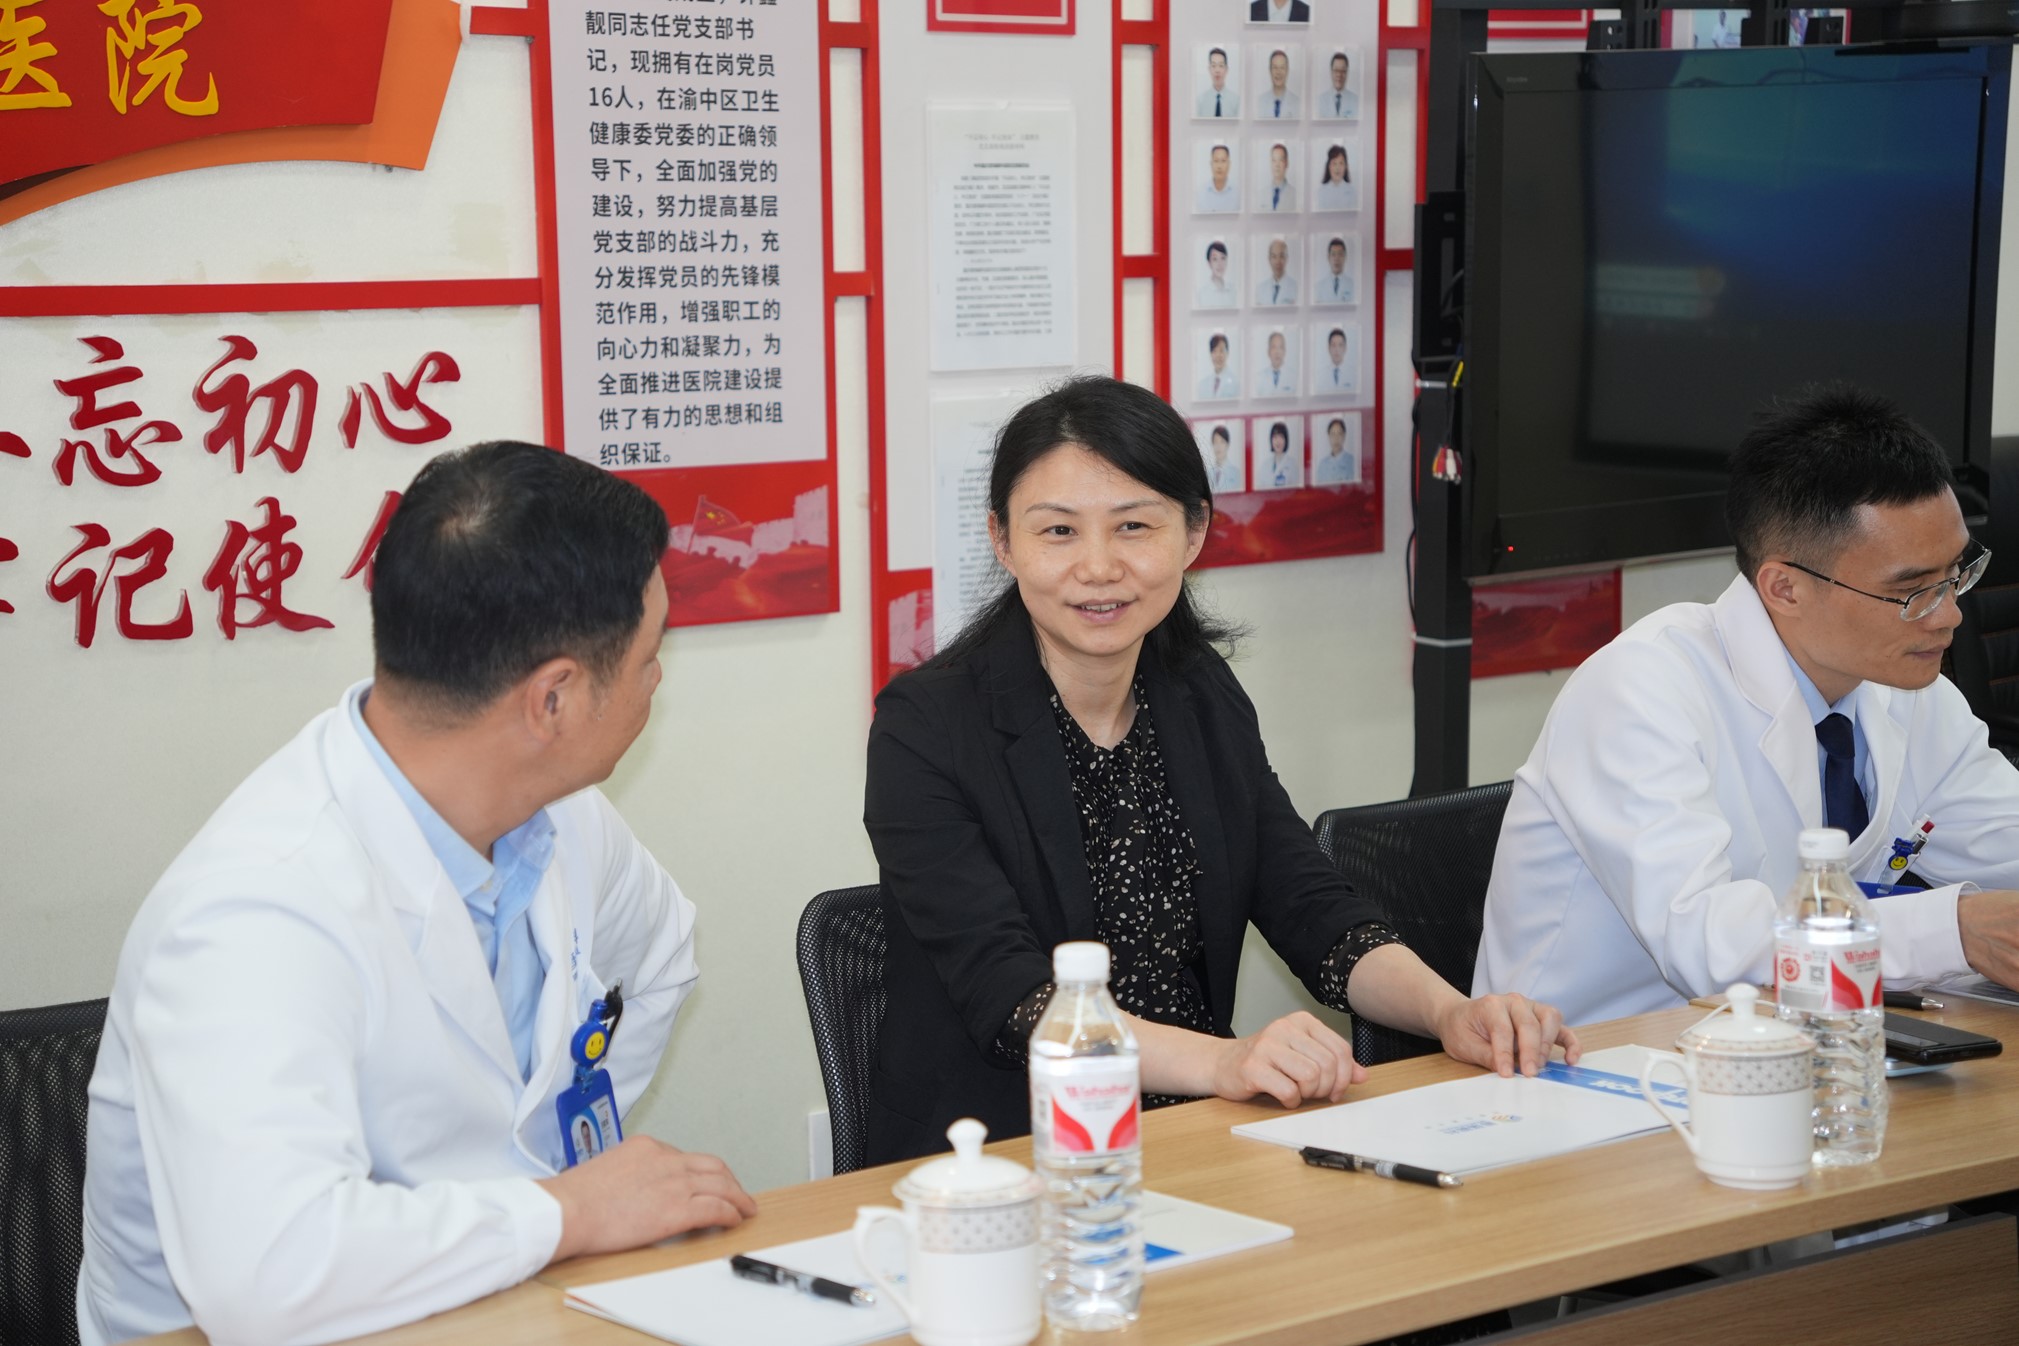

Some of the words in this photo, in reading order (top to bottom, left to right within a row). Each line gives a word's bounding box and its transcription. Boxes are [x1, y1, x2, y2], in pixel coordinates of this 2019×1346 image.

[585, 10, 754, 41] 靓同志任党支部书
[586, 48, 776, 77] 记，现拥有在岗党员
[588, 86, 780, 113] 16人，在渝中区卫生
[589, 121, 778, 148] 健康委党委的正确领
[591, 157, 778, 183] 导下，全面加强党的
[592, 193, 778, 219] 建设，努力提高基层
[593, 229, 780, 254] 党支部的战斗力，充
[594, 264, 780, 289] 分发挥党员的先锋模
[595, 299, 781, 325] 范作用，增强职工的
[597, 333, 781, 361] 向心力和凝聚力，为
[598, 367, 782, 396] 全面推进医院建设提
[0, 335, 461, 487] 忘初心
[598, 401, 783, 431] 供了有力的思想和组
[599, 441, 672, 466] 织保证。
[0, 491, 402, 649] 记使
